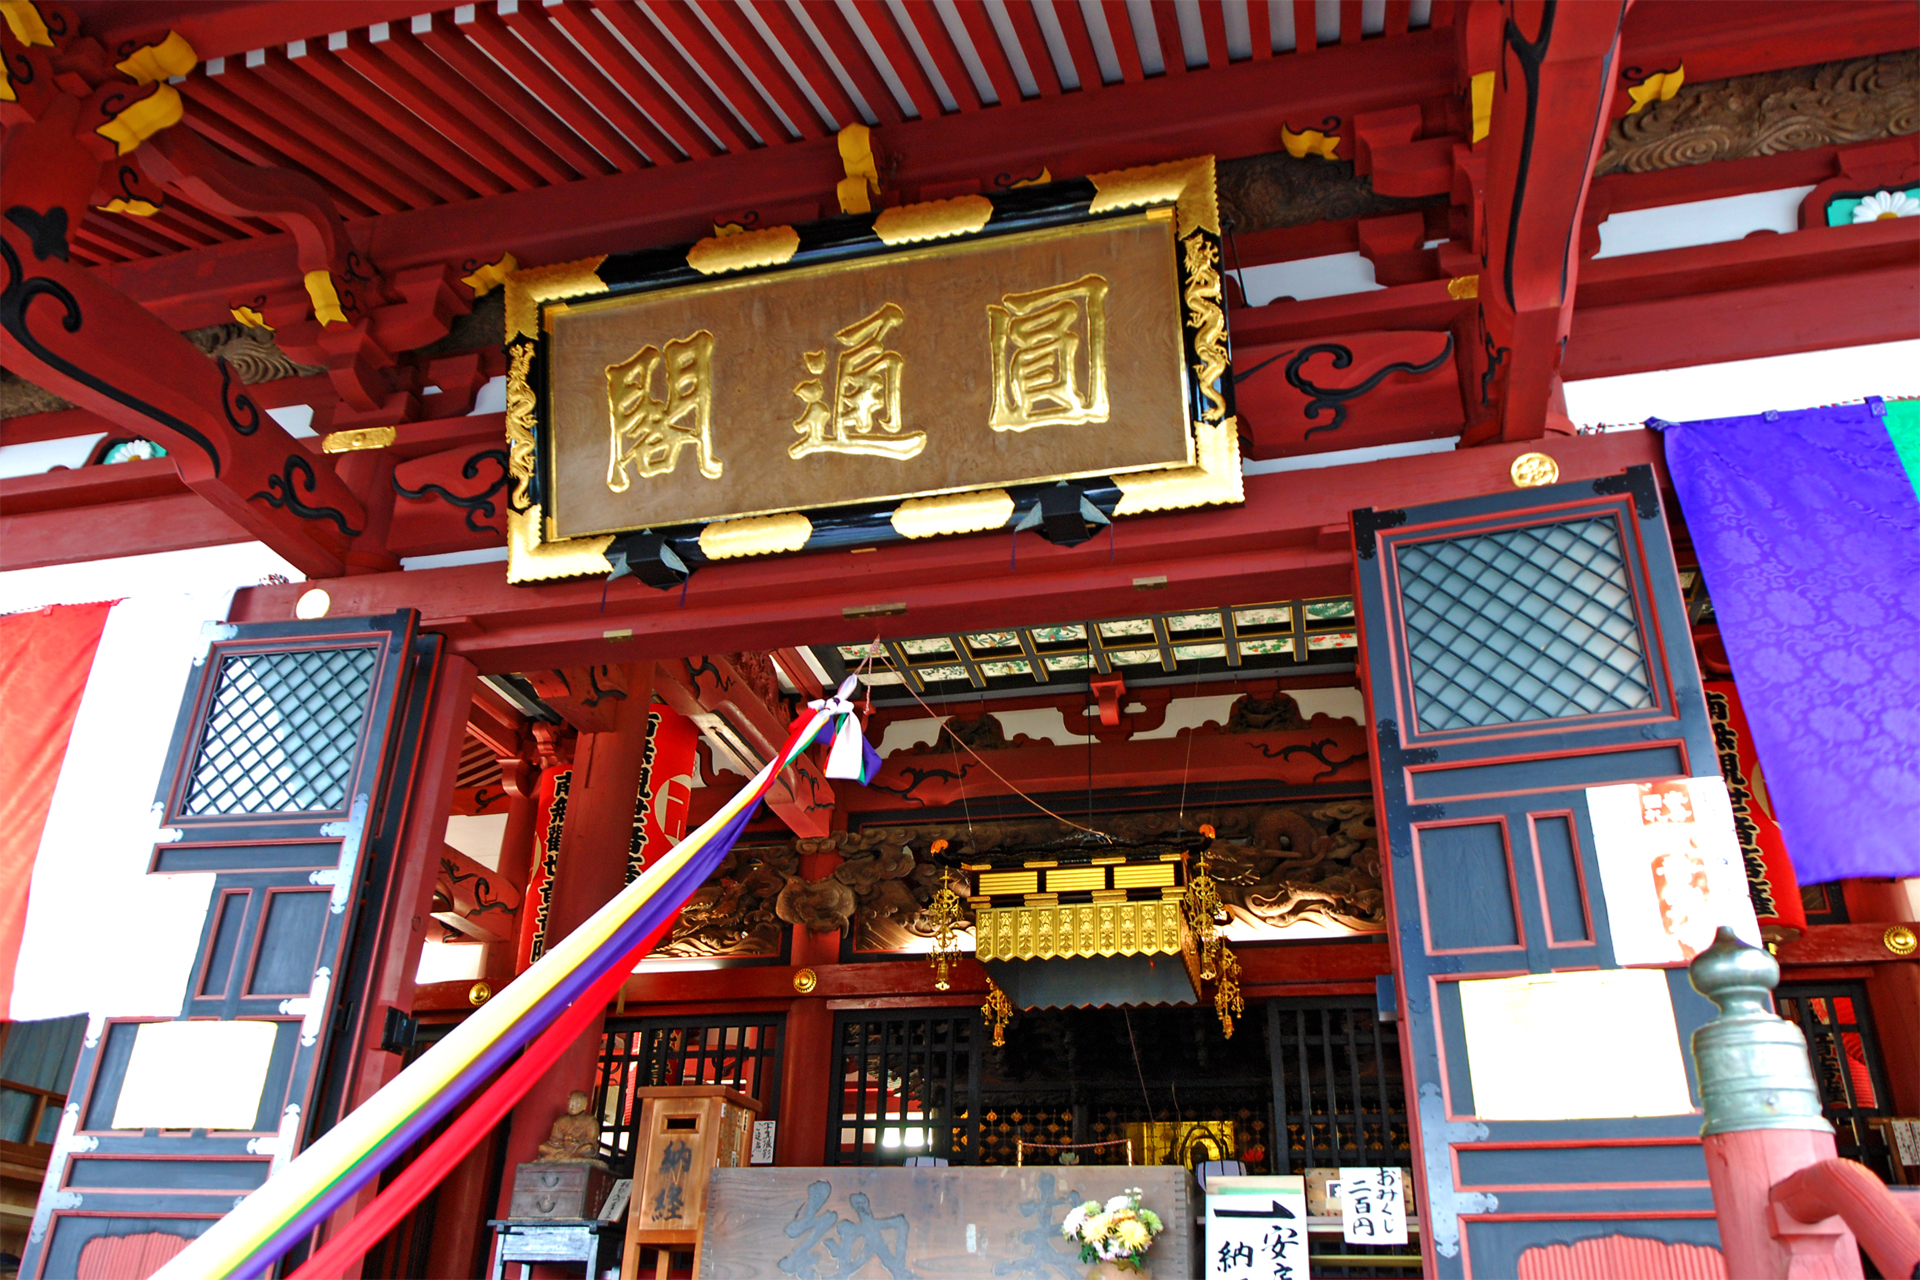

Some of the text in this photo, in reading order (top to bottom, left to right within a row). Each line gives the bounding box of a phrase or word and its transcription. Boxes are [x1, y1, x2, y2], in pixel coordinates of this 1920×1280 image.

[1348, 1180, 1375, 1236] 二百円
[1375, 1166, 1398, 1233] おみくじ
[1217, 1241, 1253, 1280] 納
